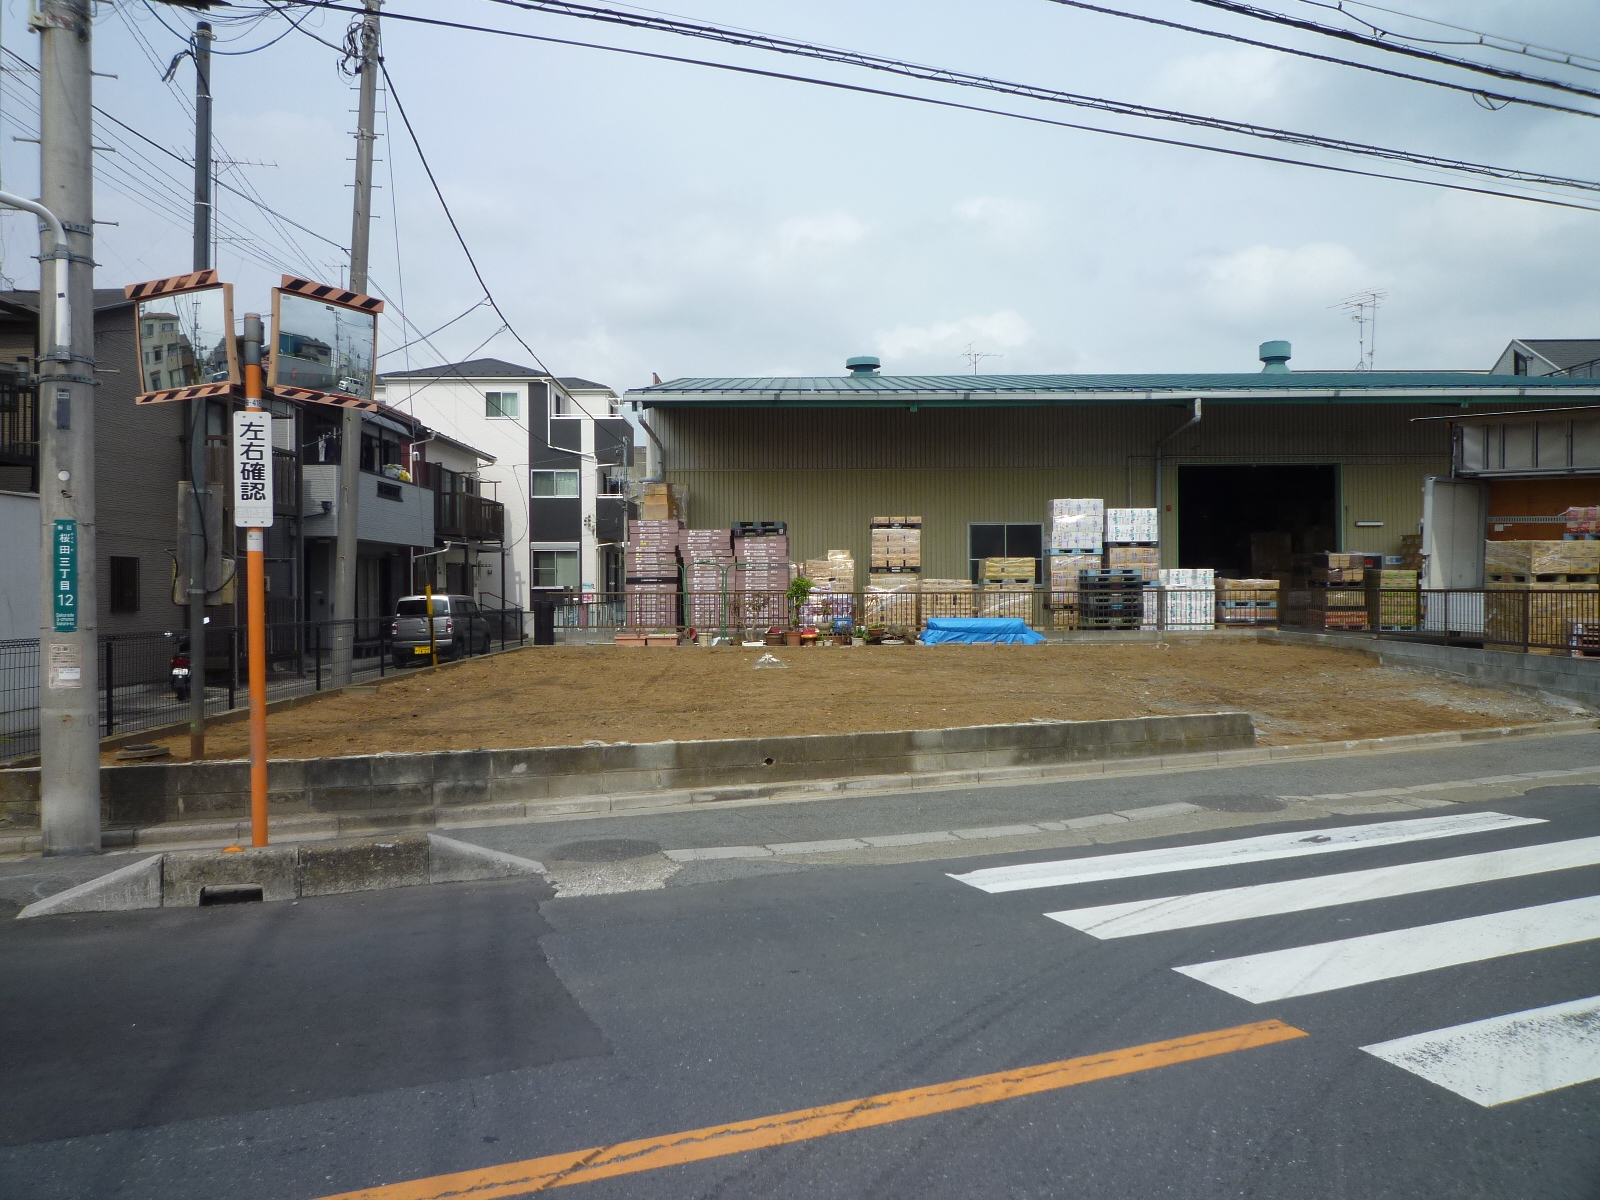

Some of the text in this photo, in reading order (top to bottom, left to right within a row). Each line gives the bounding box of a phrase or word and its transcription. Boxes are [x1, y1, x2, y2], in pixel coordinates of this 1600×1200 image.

[240, 422, 266, 501] 左右確認
[59, 533, 71, 591] 桜田三丁目
[57, 594, 74, 606] 12
